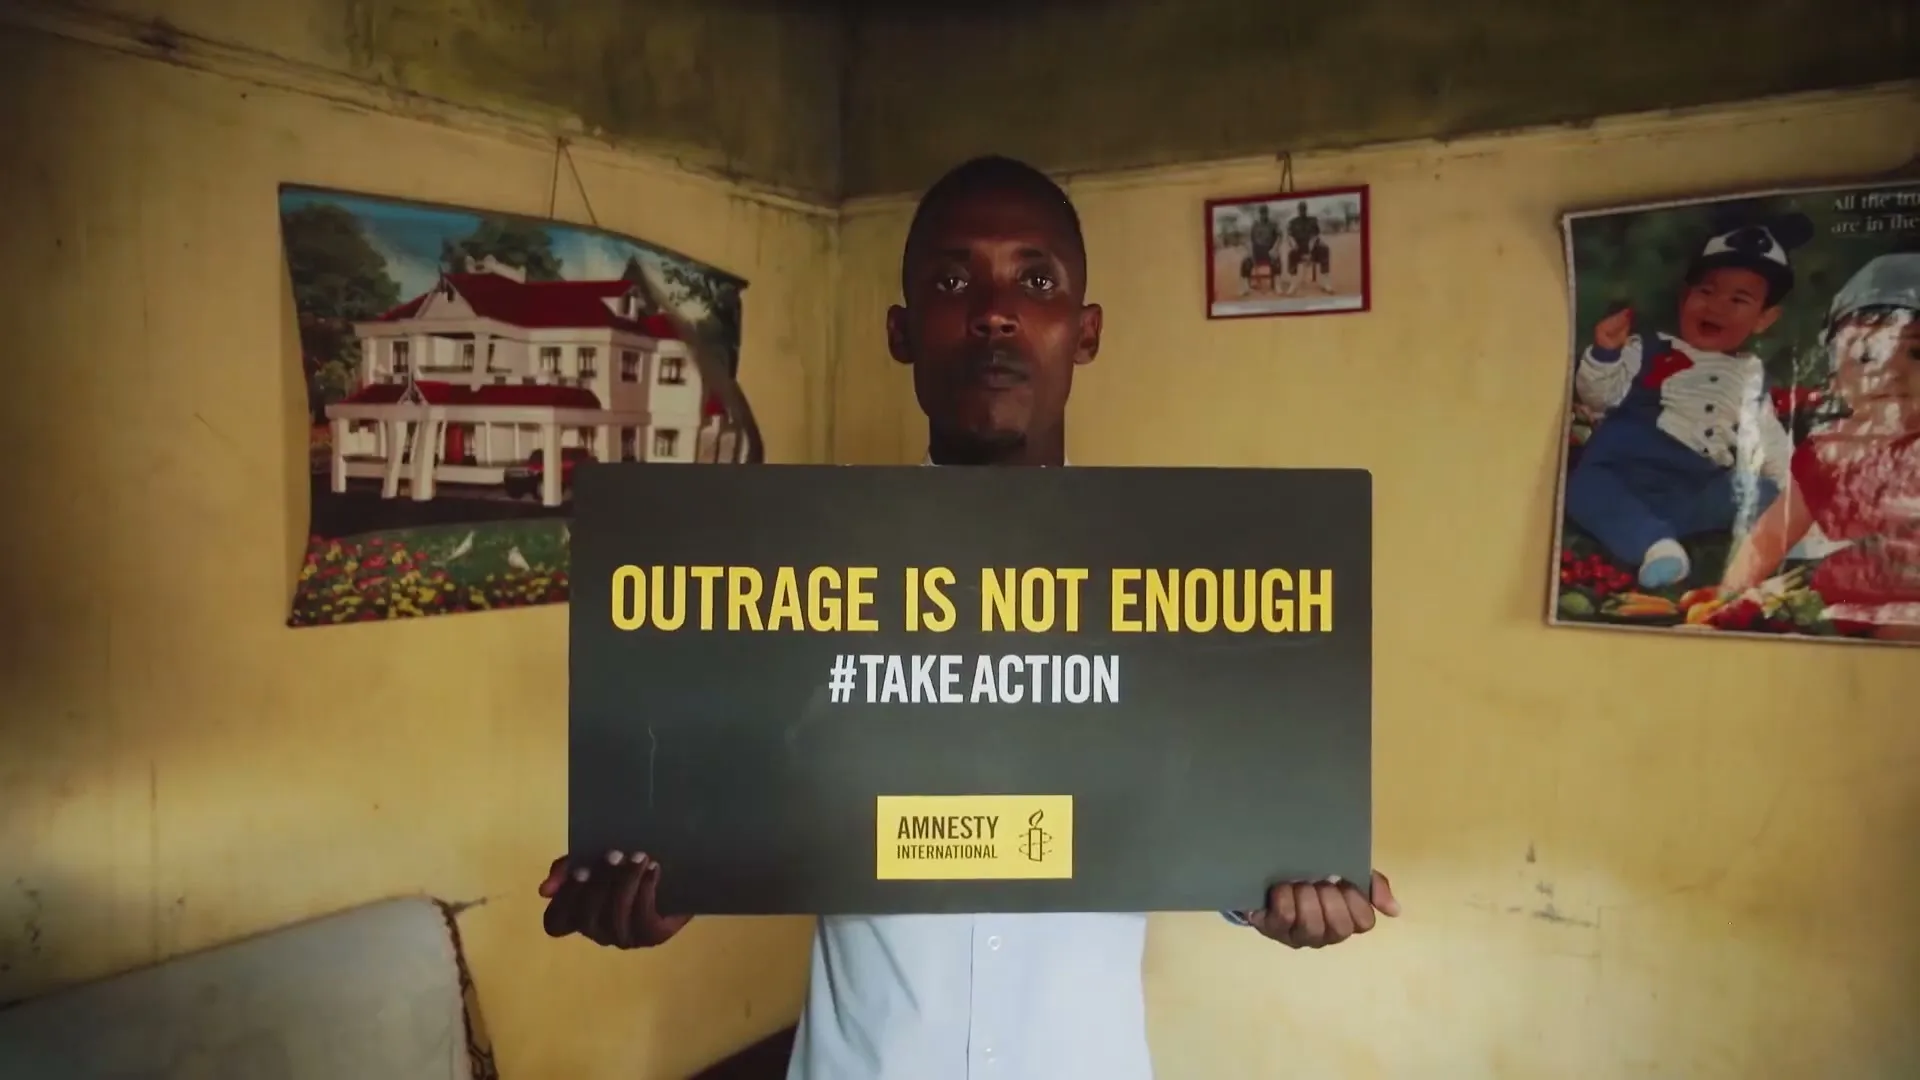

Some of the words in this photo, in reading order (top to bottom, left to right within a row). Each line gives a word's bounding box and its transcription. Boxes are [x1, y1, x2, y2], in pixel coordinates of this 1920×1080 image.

[1832, 195, 1855, 211] All
[1830, 221, 1859, 233] are
[1866, 216, 1884, 231] in
[611, 565, 879, 632] OUTRAGE
[905, 567, 957, 632] IS
[981, 567, 1089, 633] NOT
[1111, 568, 1333, 633] ENOUGH
[828, 654, 964, 704] #TAKE
[969, 654, 1120, 704] ACTION
[897, 815, 999, 840] AMNESTY
[897, 844, 998, 859] INTERNATIONAL
